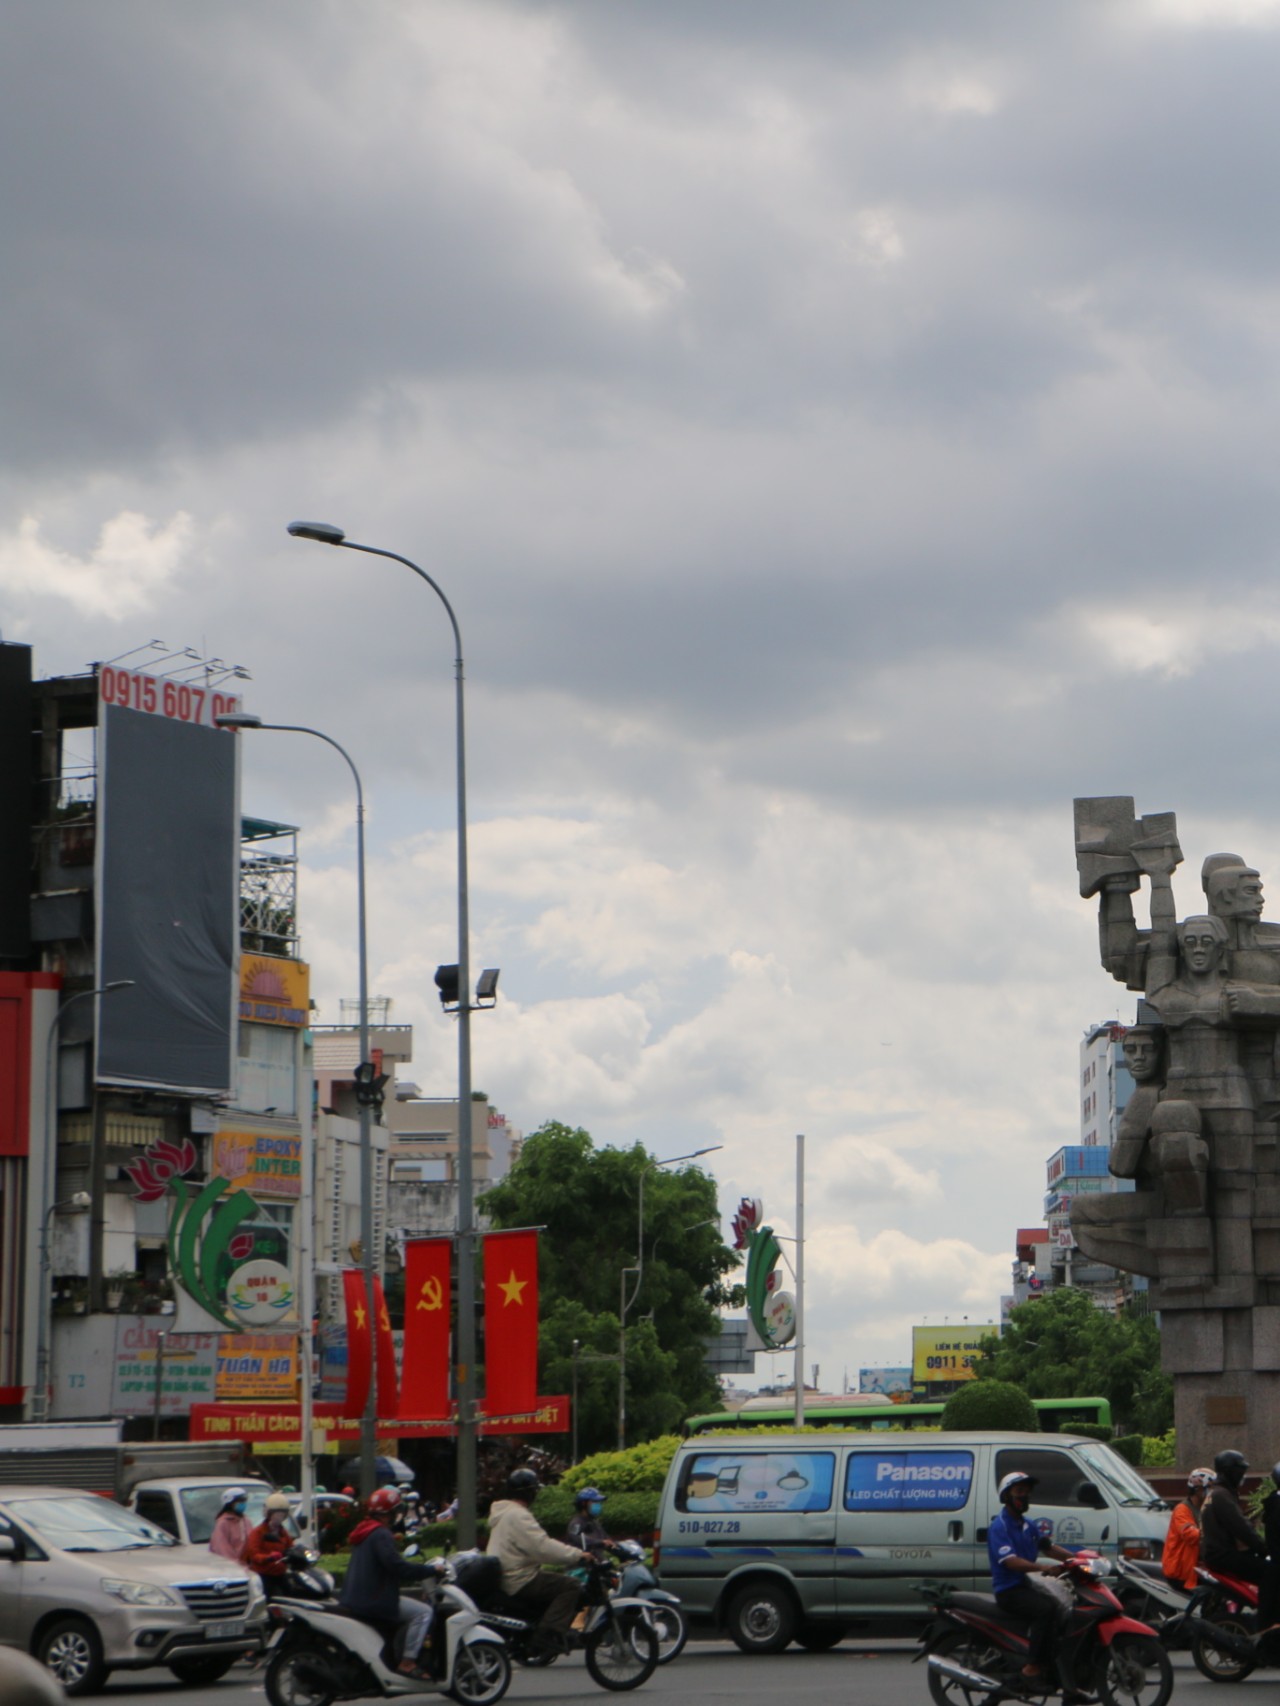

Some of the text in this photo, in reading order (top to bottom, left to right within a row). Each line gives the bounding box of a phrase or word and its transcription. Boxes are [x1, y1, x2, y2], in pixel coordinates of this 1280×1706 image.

[101, 666, 156, 713] 0915
[163, 682, 205, 724] 607
[68, 1374, 86, 1388] T2
[853, 1489, 871, 1500] LED
[873, 1487, 900, 1500] CHẤT
[902, 1487, 935, 1501] LƯỢNG
[679, 1521, 740, 1534] 51D-027.28
[889, 1550, 932, 1560] TOYOTA
